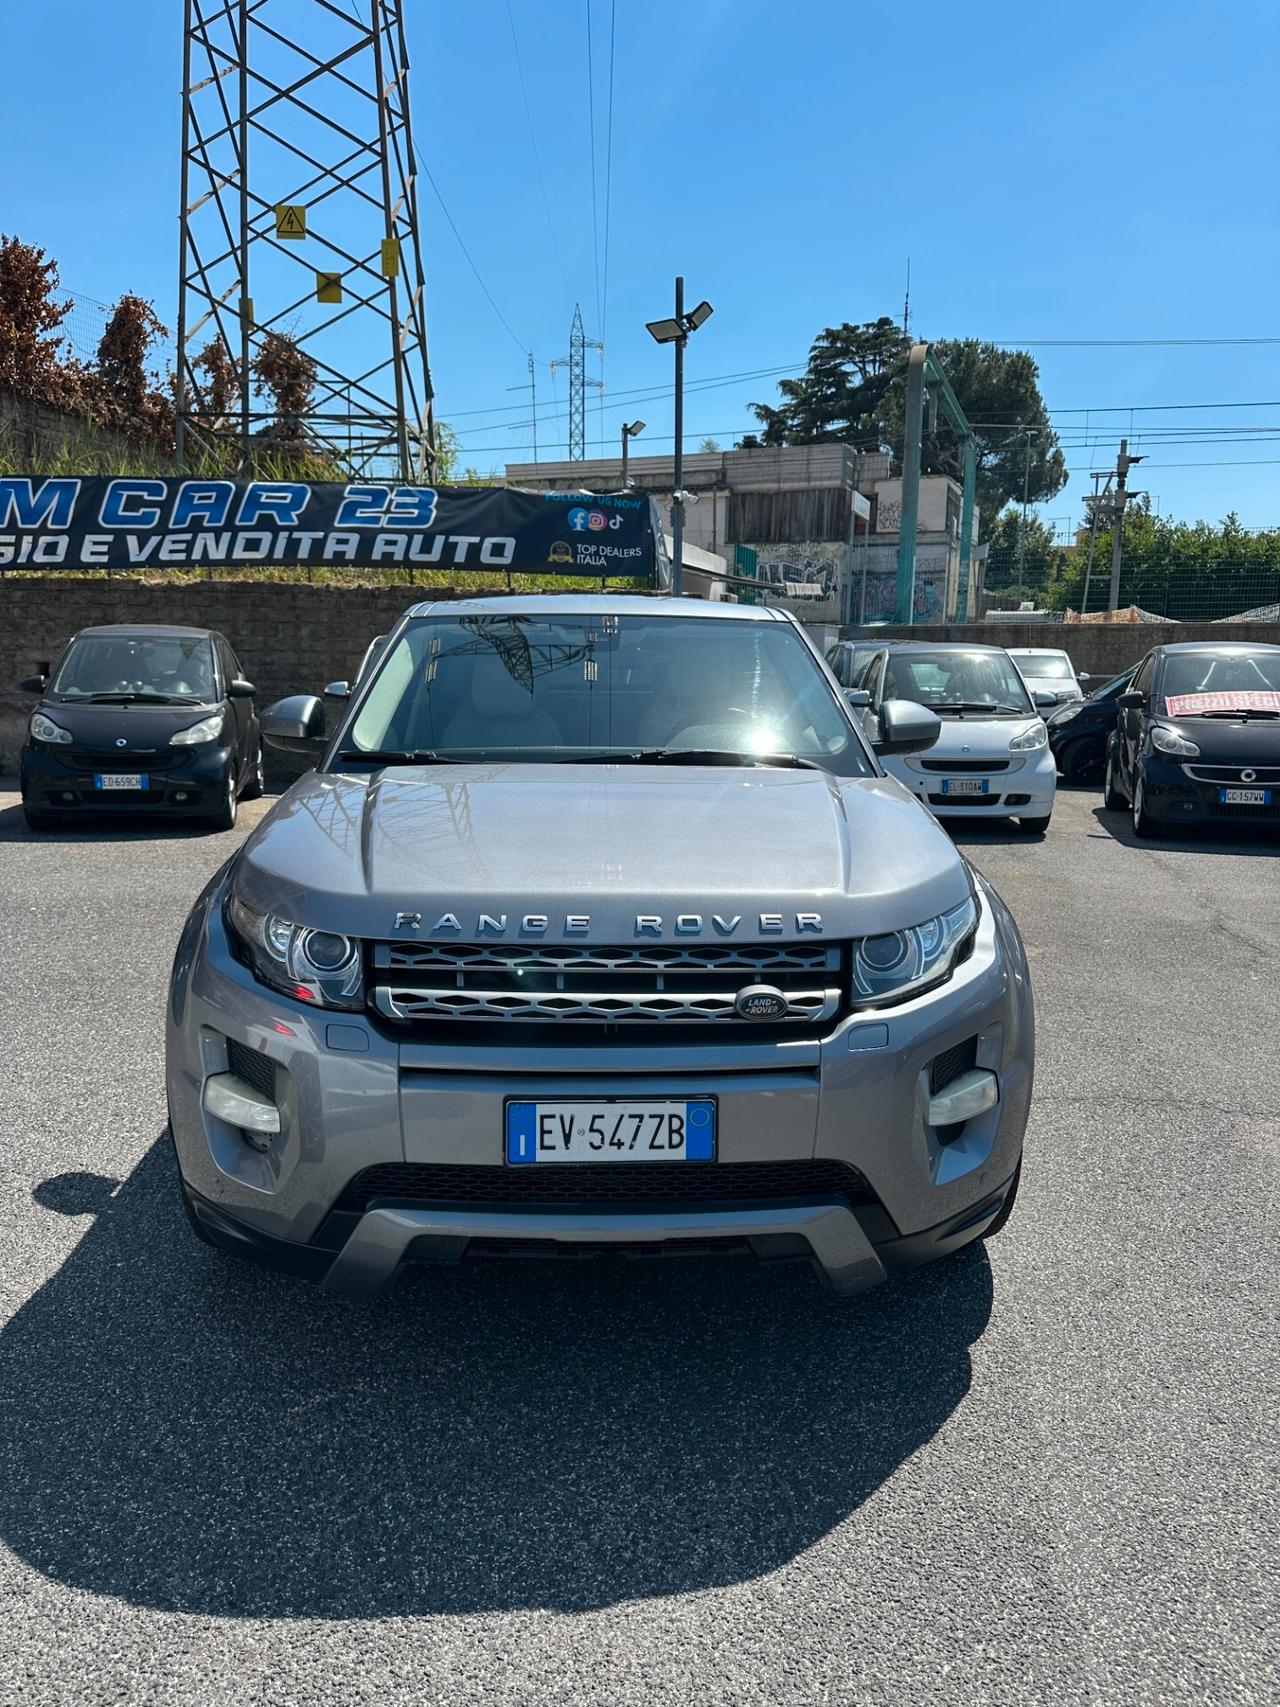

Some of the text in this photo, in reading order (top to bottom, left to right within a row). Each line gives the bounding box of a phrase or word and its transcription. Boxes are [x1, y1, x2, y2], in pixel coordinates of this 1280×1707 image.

[98, 479, 311, 529] CAR
[334, 485, 438, 529] 23
[597, 495, 612, 506] US
[614, 499, 641, 509] NOW
[80, 534, 114, 563] E
[126, 531, 360, 562] VENDITA
[371, 533, 516, 565] AUTO
[577, 543, 597, 555] TOP
[599, 546, 642, 558] DEALERS
[577, 554, 607, 566] ITALIA
[393, 911, 823, 933] RANGE ROVER
